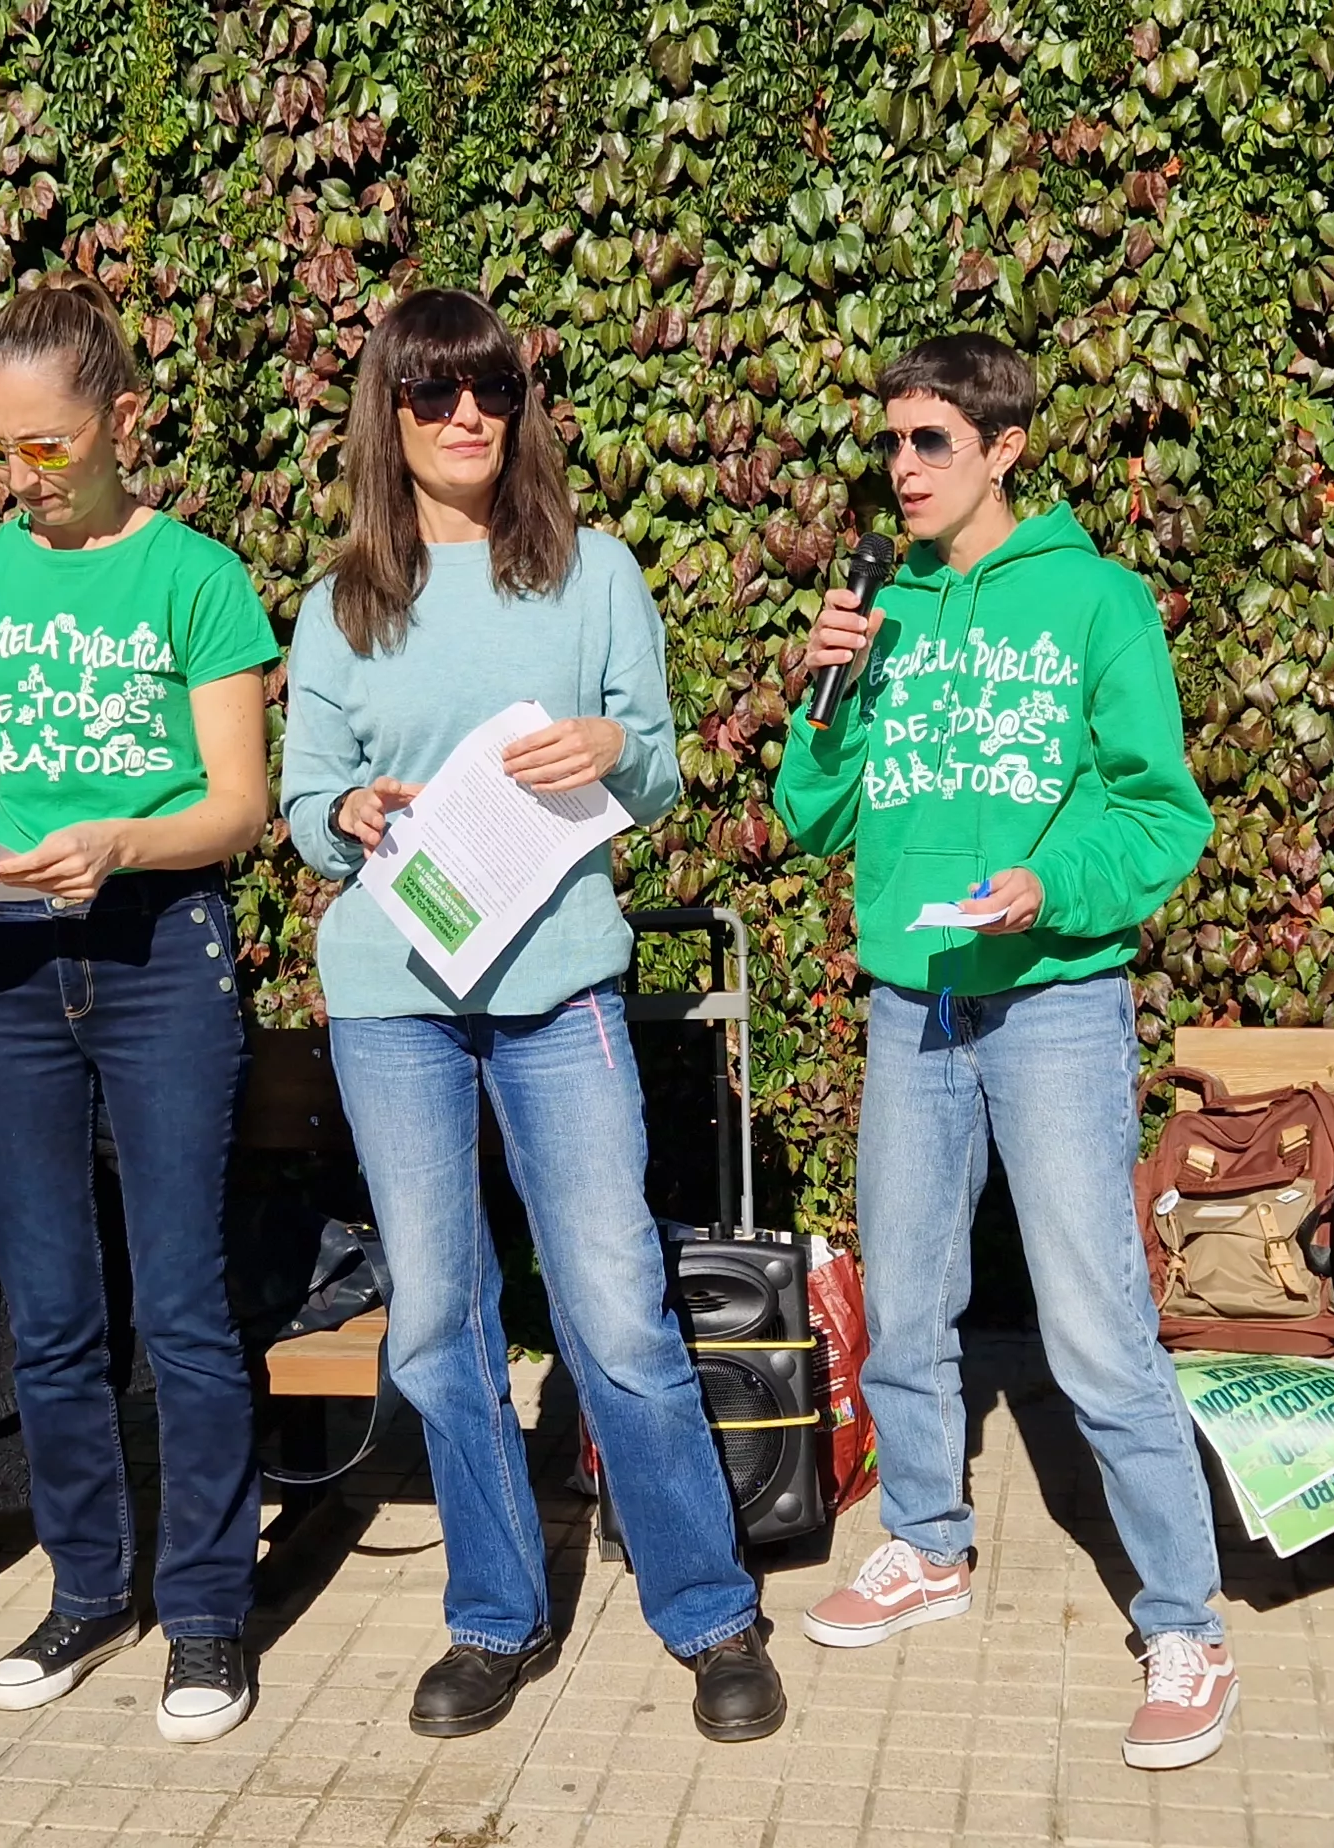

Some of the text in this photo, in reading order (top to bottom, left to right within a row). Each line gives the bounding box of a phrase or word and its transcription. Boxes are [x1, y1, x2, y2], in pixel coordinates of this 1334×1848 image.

[974, 636, 1078, 686] PÚBLICA:
[30, 691, 151, 728] TOD@S
[884, 707, 1046, 747] DE TOD@S
[52, 744, 174, 777] TOD@S
[950, 762, 1063, 804] TOD@S
